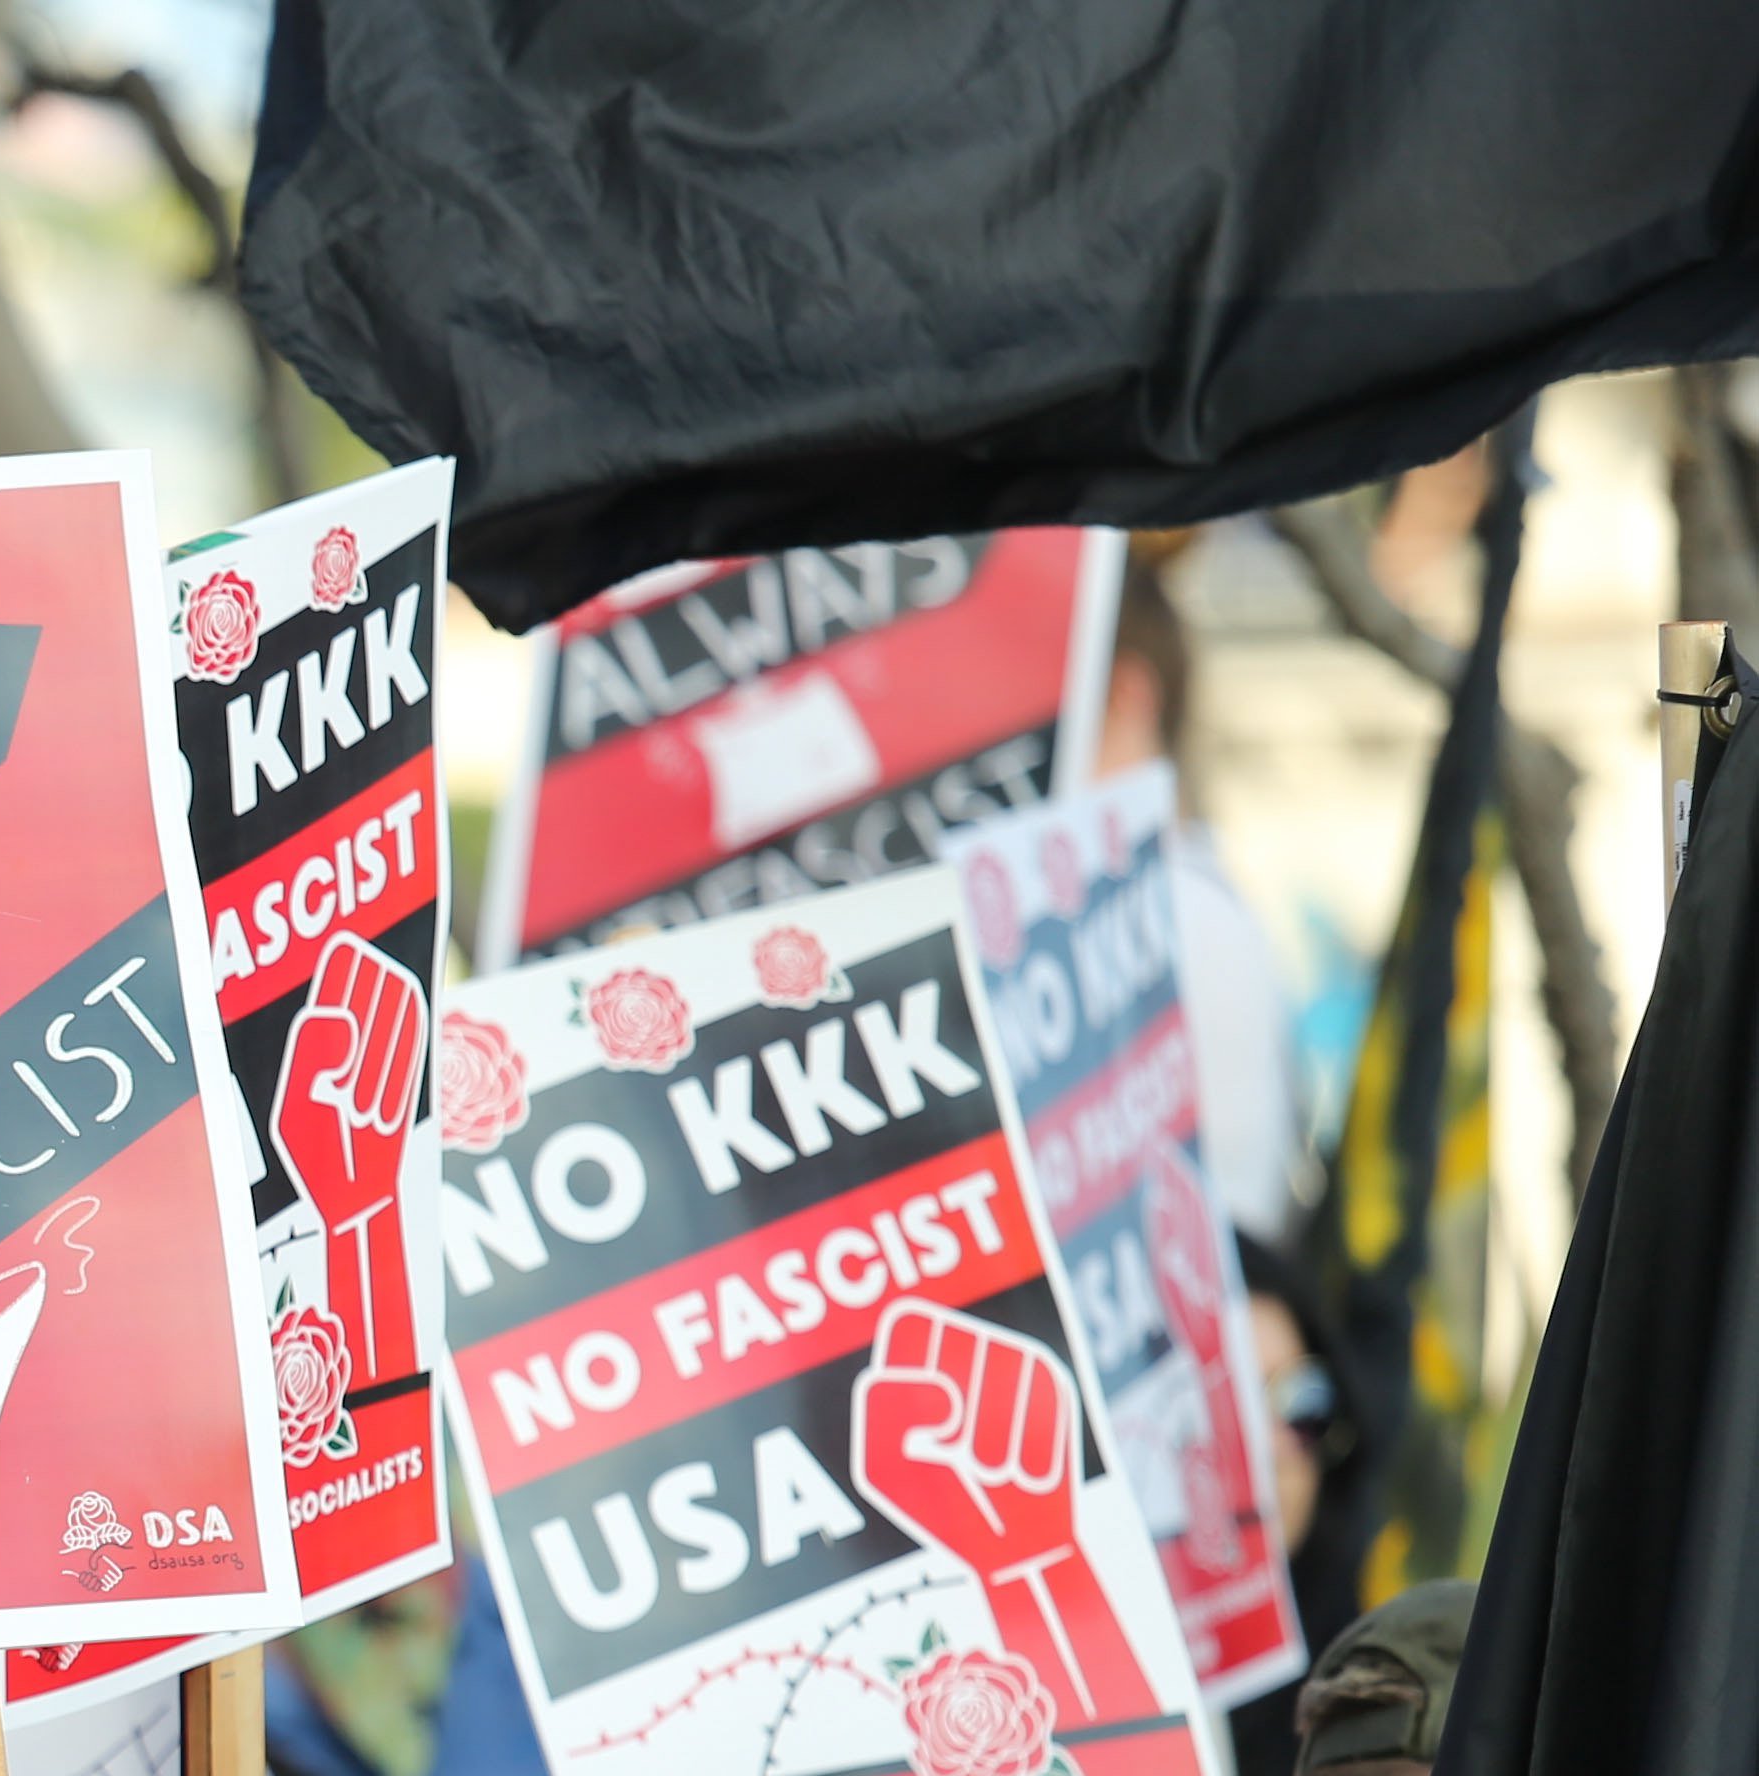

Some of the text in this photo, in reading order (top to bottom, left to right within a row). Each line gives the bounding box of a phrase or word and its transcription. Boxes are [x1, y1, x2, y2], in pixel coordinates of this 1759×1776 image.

[226, 583, 429, 817] KKK
[213, 790, 423, 994] ASCIST
[442, 978, 982, 1296] NO KKK
[489, 1169, 1003, 1446] NO FASCIST
[142, 1504, 234, 1549] DSA
[148, 1549, 245, 1571] dsausa.org
[290, 1446, 424, 1530] SOCIALISTS
[531, 1425, 865, 1632] USA
